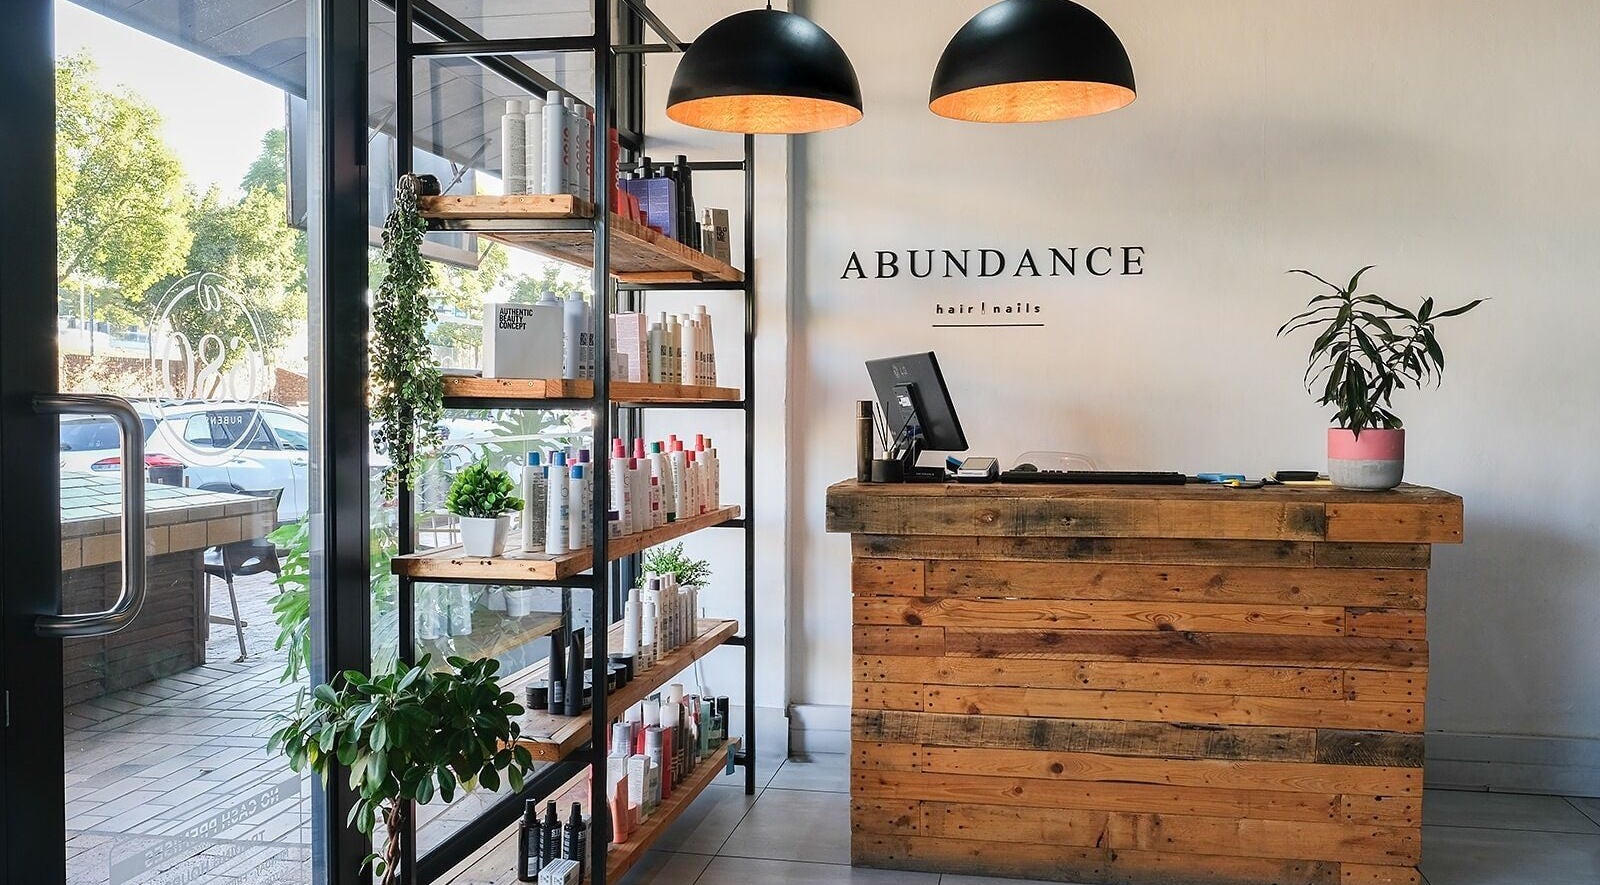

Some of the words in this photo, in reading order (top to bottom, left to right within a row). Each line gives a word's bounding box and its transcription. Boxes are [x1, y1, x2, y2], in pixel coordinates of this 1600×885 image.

[840, 246, 1146, 280] ABUNDANCE
[499, 307, 534, 317] AUTHENTIC
[936, 304, 973, 314] hair
[993, 302, 1041, 313] nails
[499, 314, 524, 323] BEAUTY
[499, 322, 527, 330] CONCEPT
